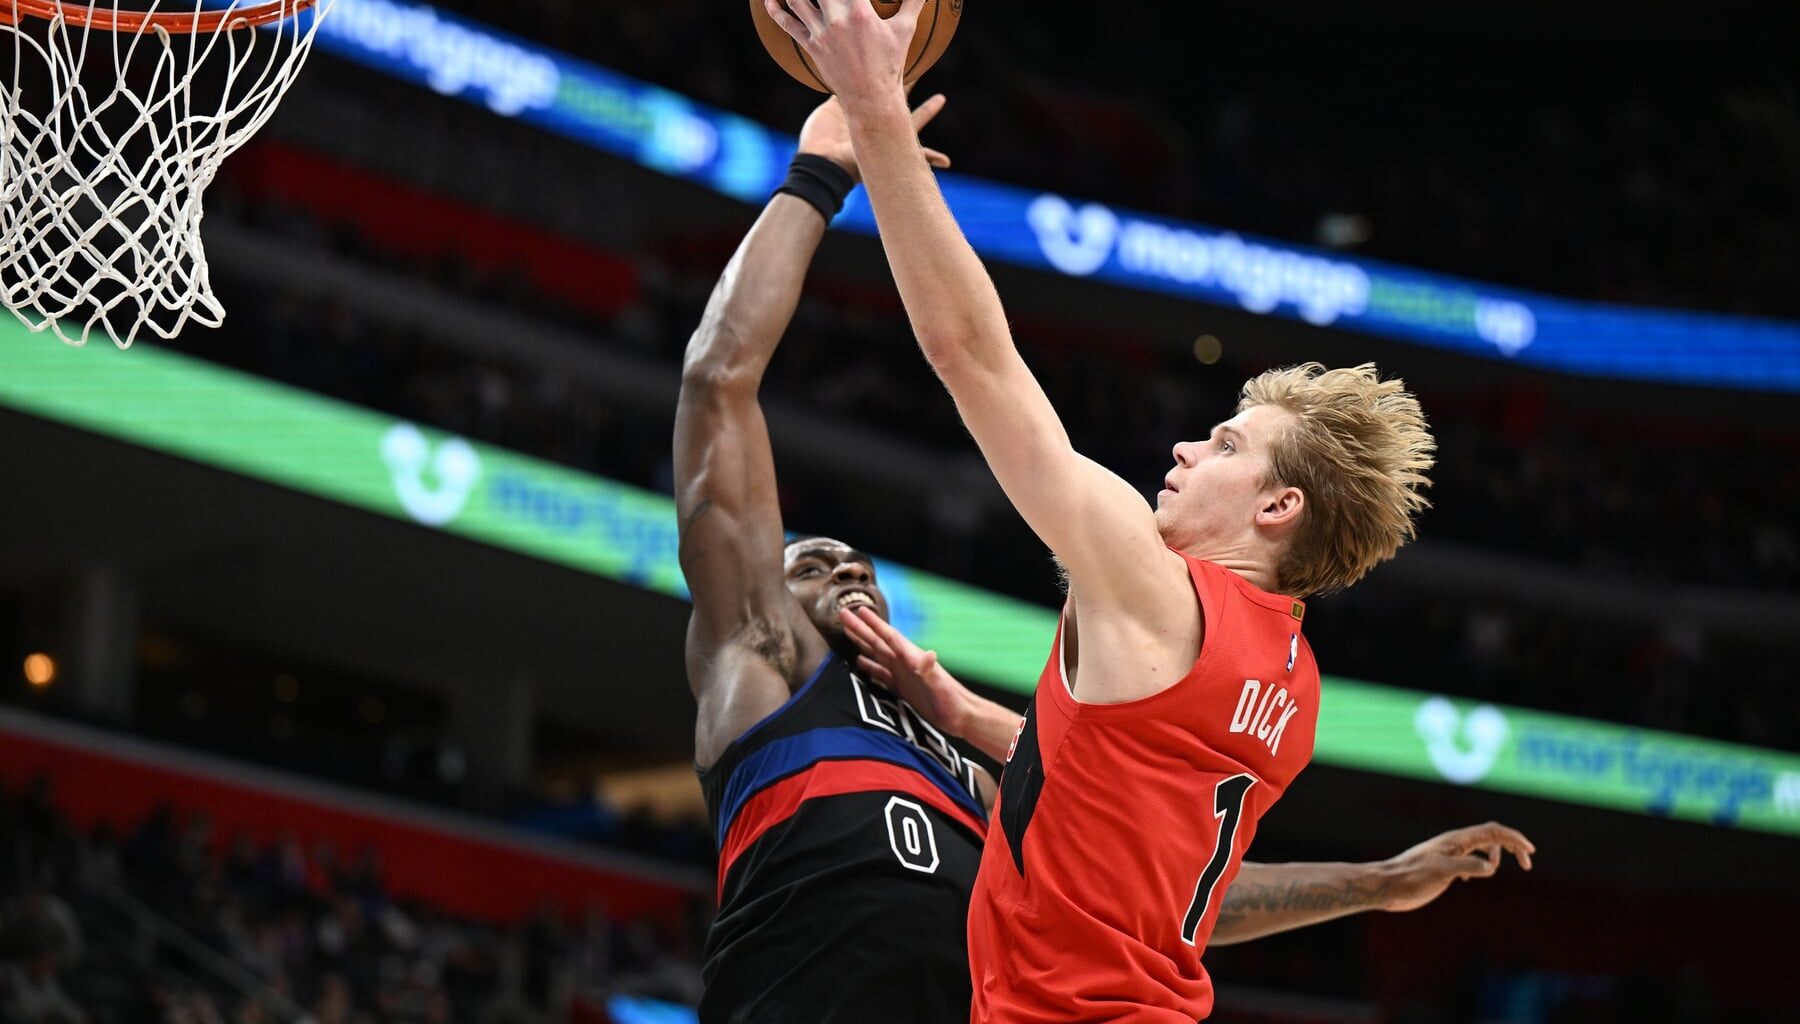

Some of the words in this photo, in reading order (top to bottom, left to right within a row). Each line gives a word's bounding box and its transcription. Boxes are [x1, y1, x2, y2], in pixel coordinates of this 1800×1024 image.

[1229, 679, 1298, 757] DICK
[884, 796, 940, 874] 0
[1181, 773, 1259, 947] 1
